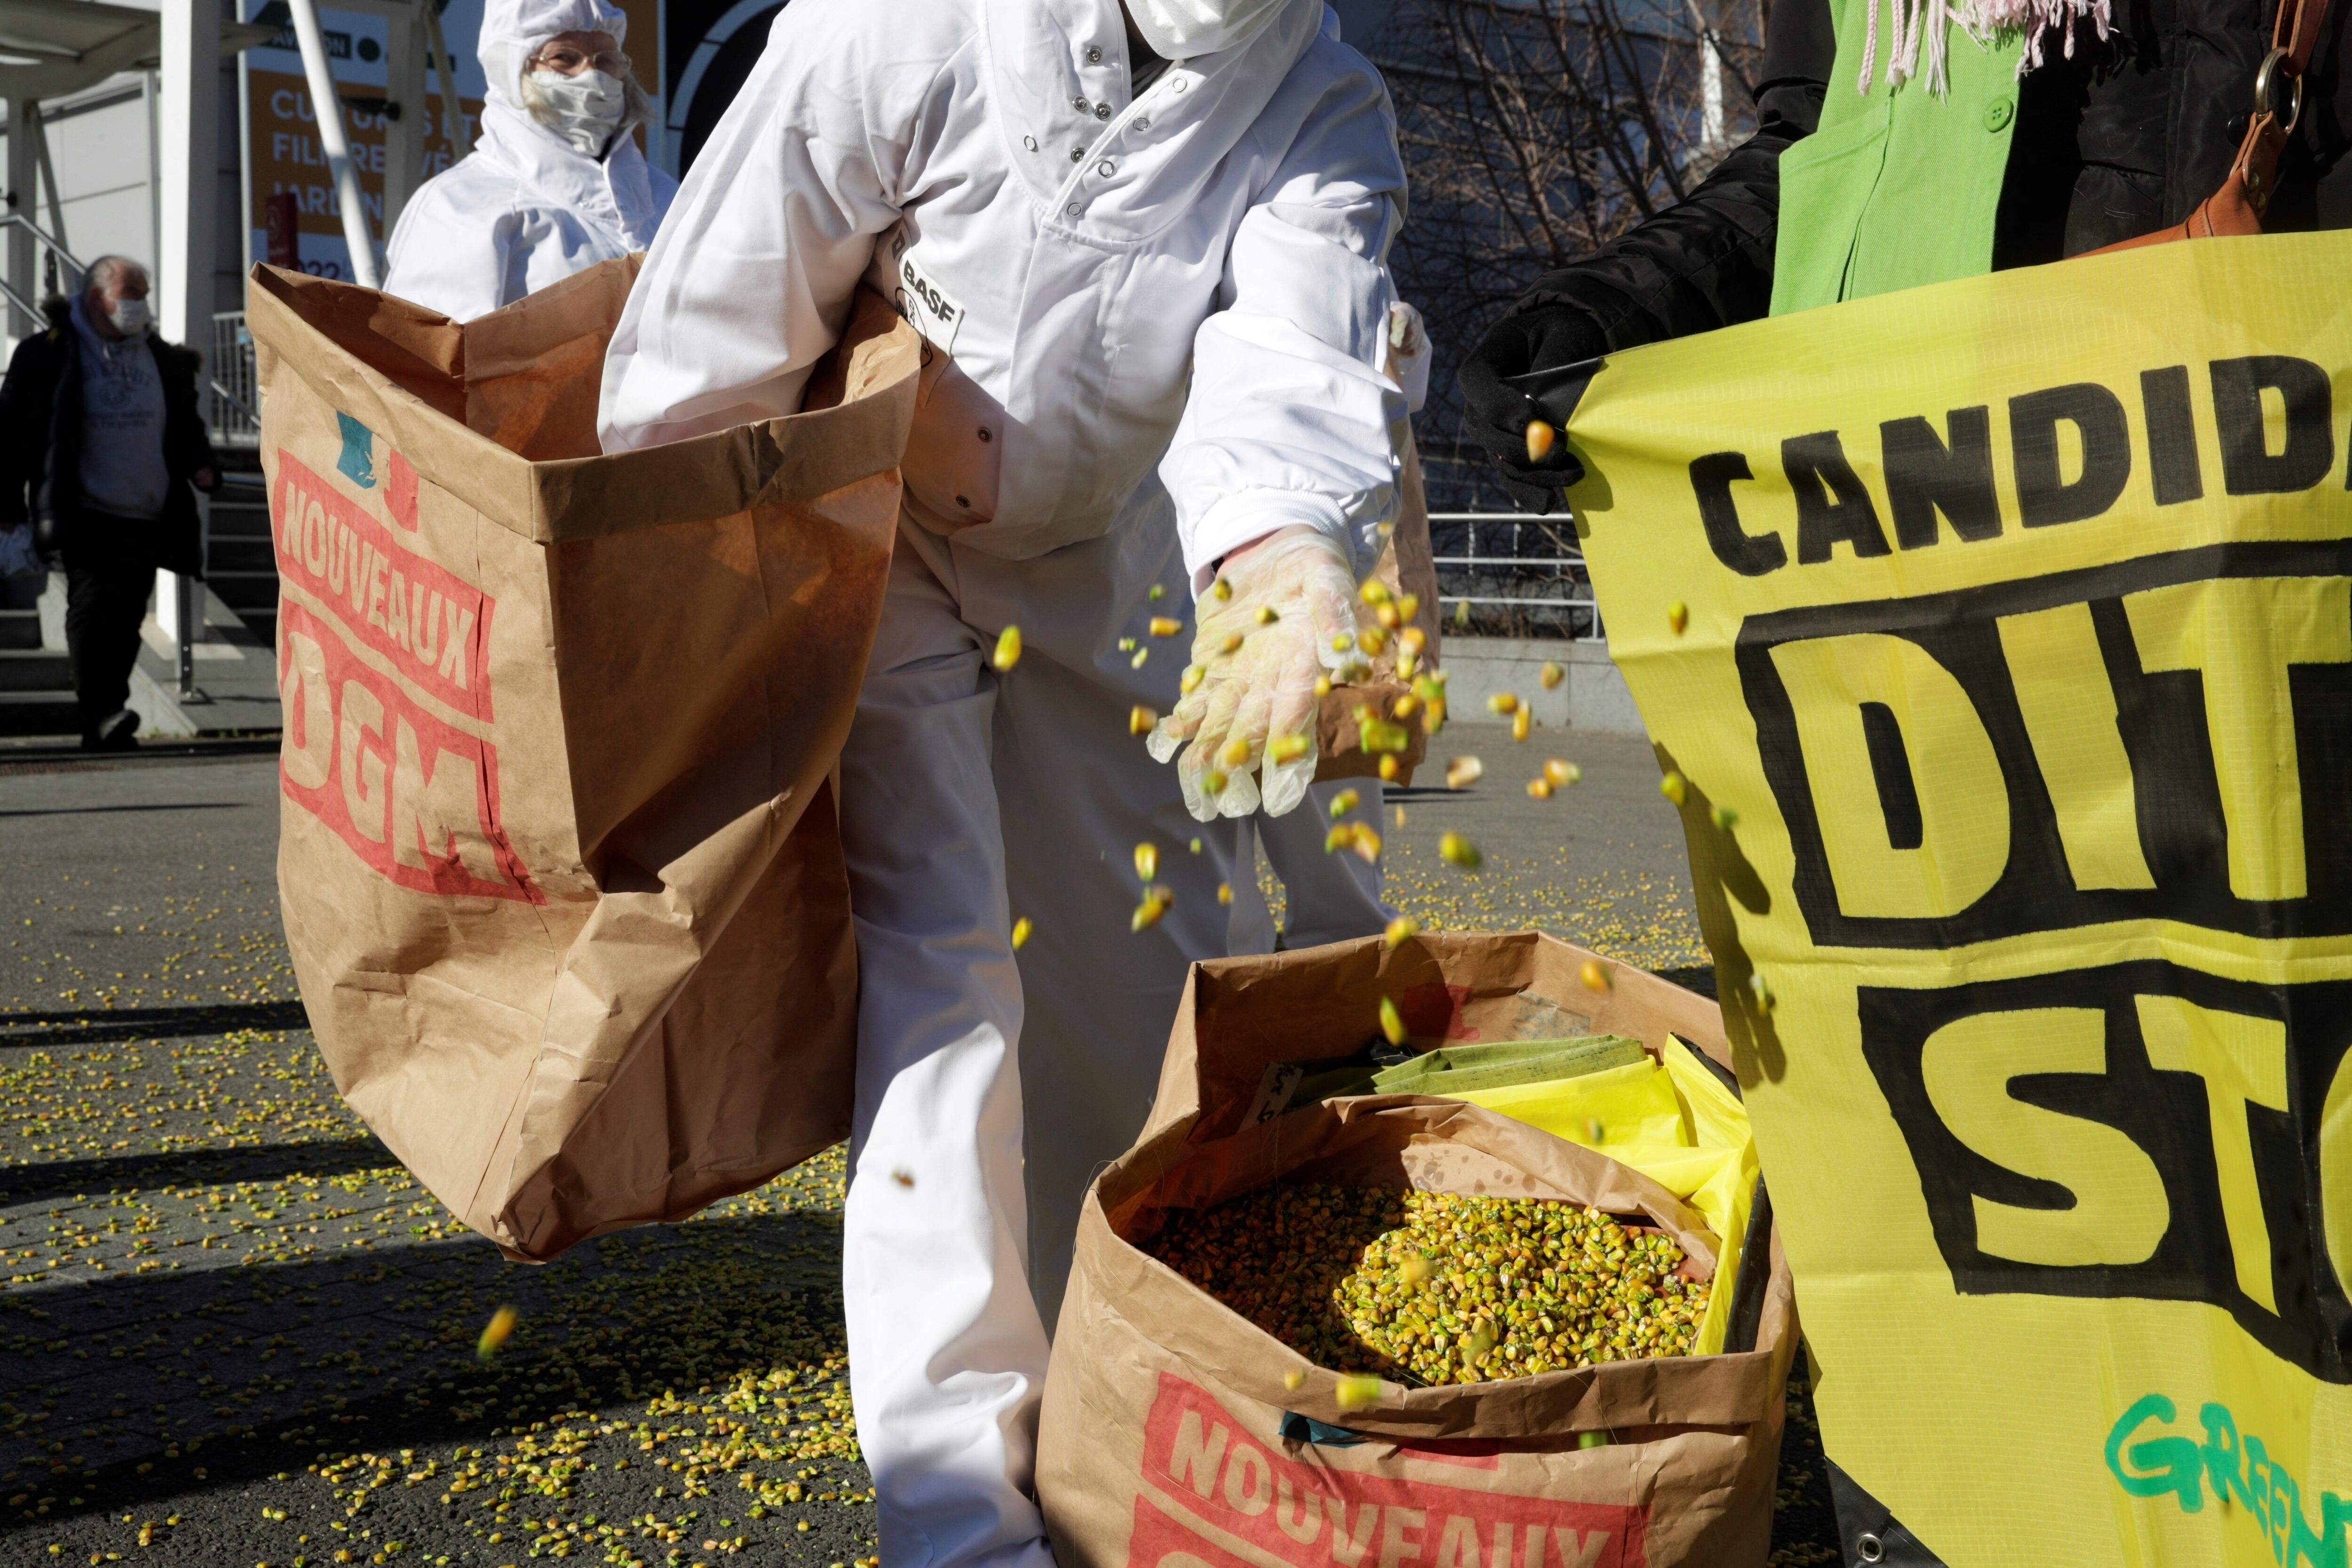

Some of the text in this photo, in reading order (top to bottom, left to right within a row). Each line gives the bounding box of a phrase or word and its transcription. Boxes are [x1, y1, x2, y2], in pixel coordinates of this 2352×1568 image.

[904, 260, 955, 322] BASF
[1689, 355, 2352, 576] CANDID
[281, 480, 475, 691] NOUVEAUX
[283, 630, 511, 886] OGM
[1922, 994, 2352, 1318] ST
[2105, 1393, 2352, 1568] GREEN
